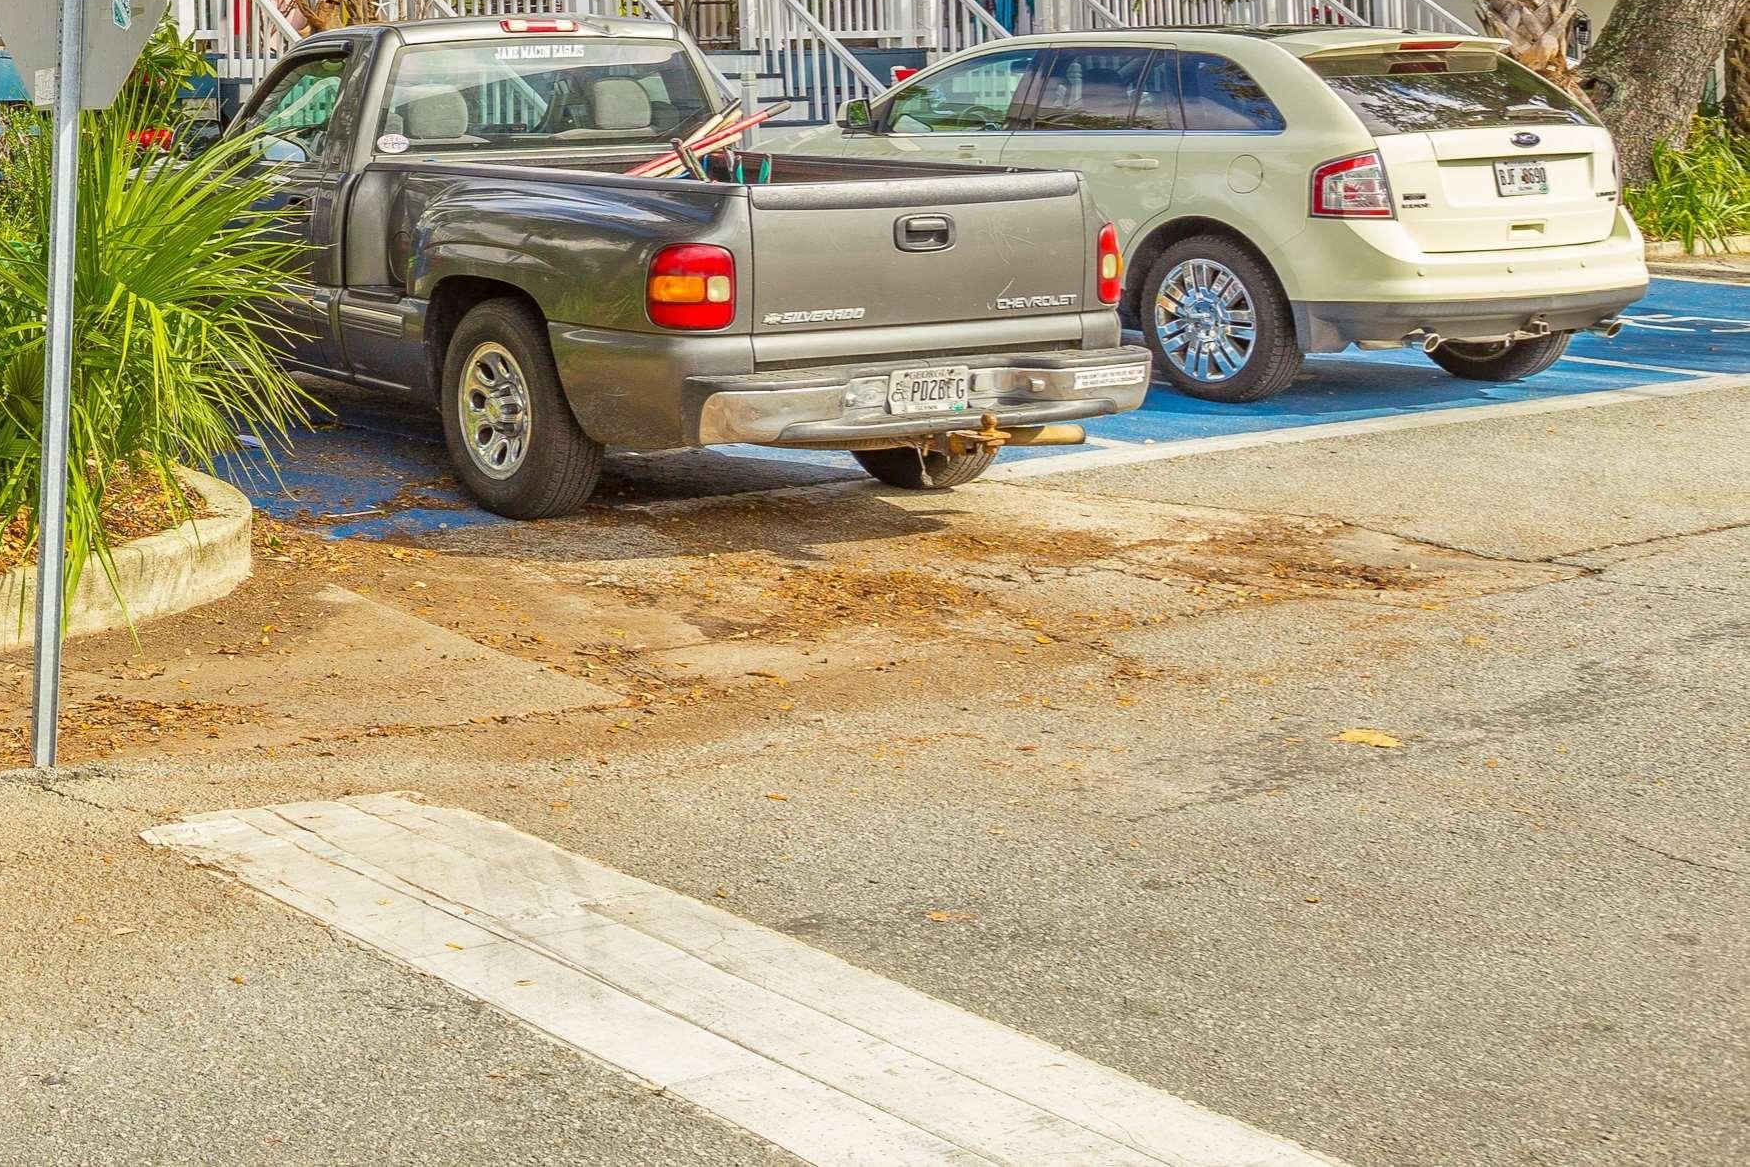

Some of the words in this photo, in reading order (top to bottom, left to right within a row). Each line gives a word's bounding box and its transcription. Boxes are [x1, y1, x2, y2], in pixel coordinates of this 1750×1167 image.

[495, 46, 520, 60] JANE
[520, 45, 551, 58] MACON
[552, 45, 585, 58] EAGLES
[996, 294, 1077, 310] CHEVROLET
[780, 307, 866, 324] SILVERADO
